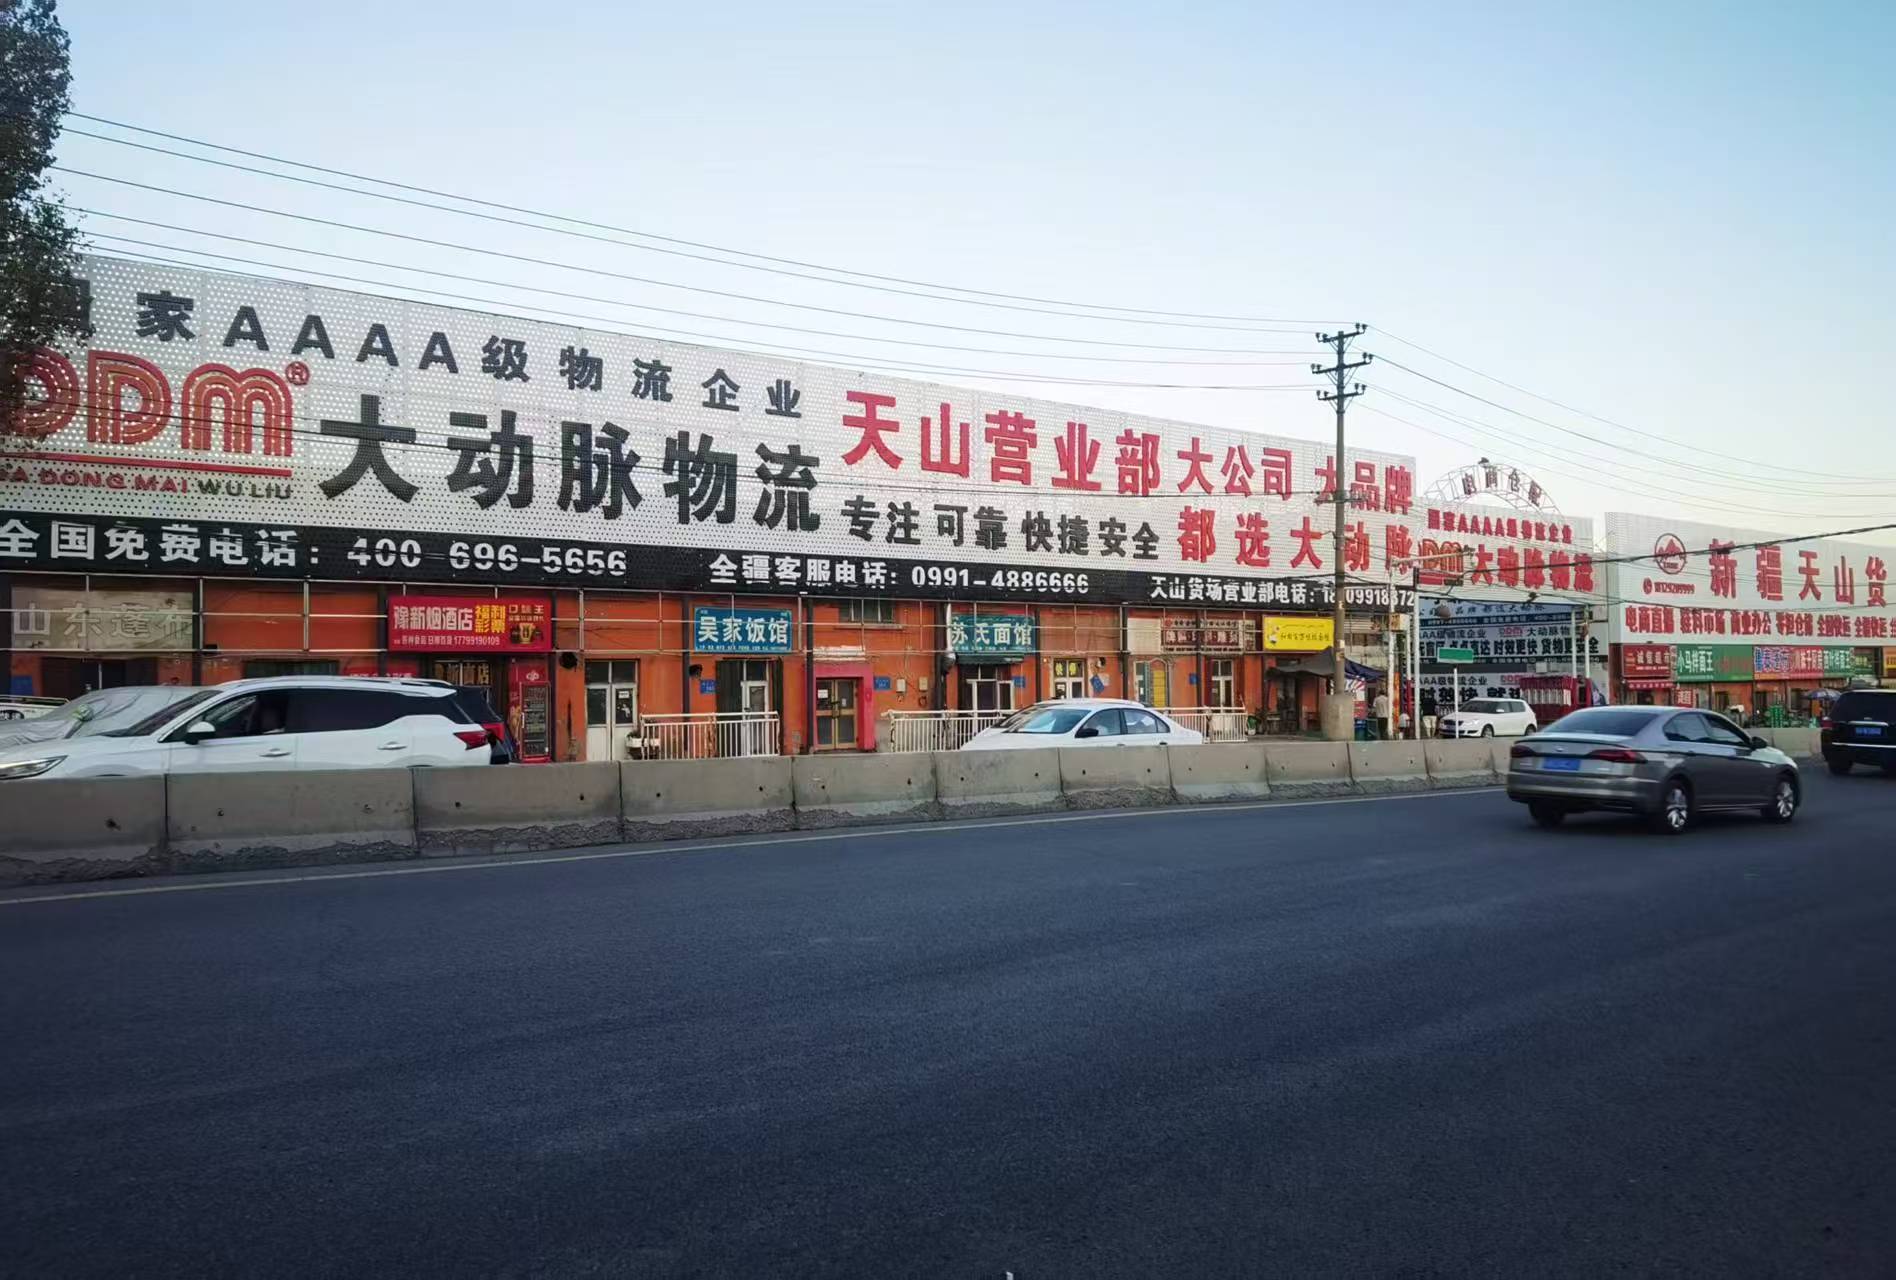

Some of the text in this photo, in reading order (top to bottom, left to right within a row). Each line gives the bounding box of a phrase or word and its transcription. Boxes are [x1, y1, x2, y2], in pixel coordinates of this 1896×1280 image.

[318, 395, 820, 531] 大动脉物流
[1177, 505, 1413, 574] 都选大动脉
[1471, 544, 1593, 592] 大动脉物流
[1709, 538, 1887, 607] 新疆天山货
[698, 616, 789, 644] 吴家饭馆
[951, 622, 1032, 646] 苏氏面馆
